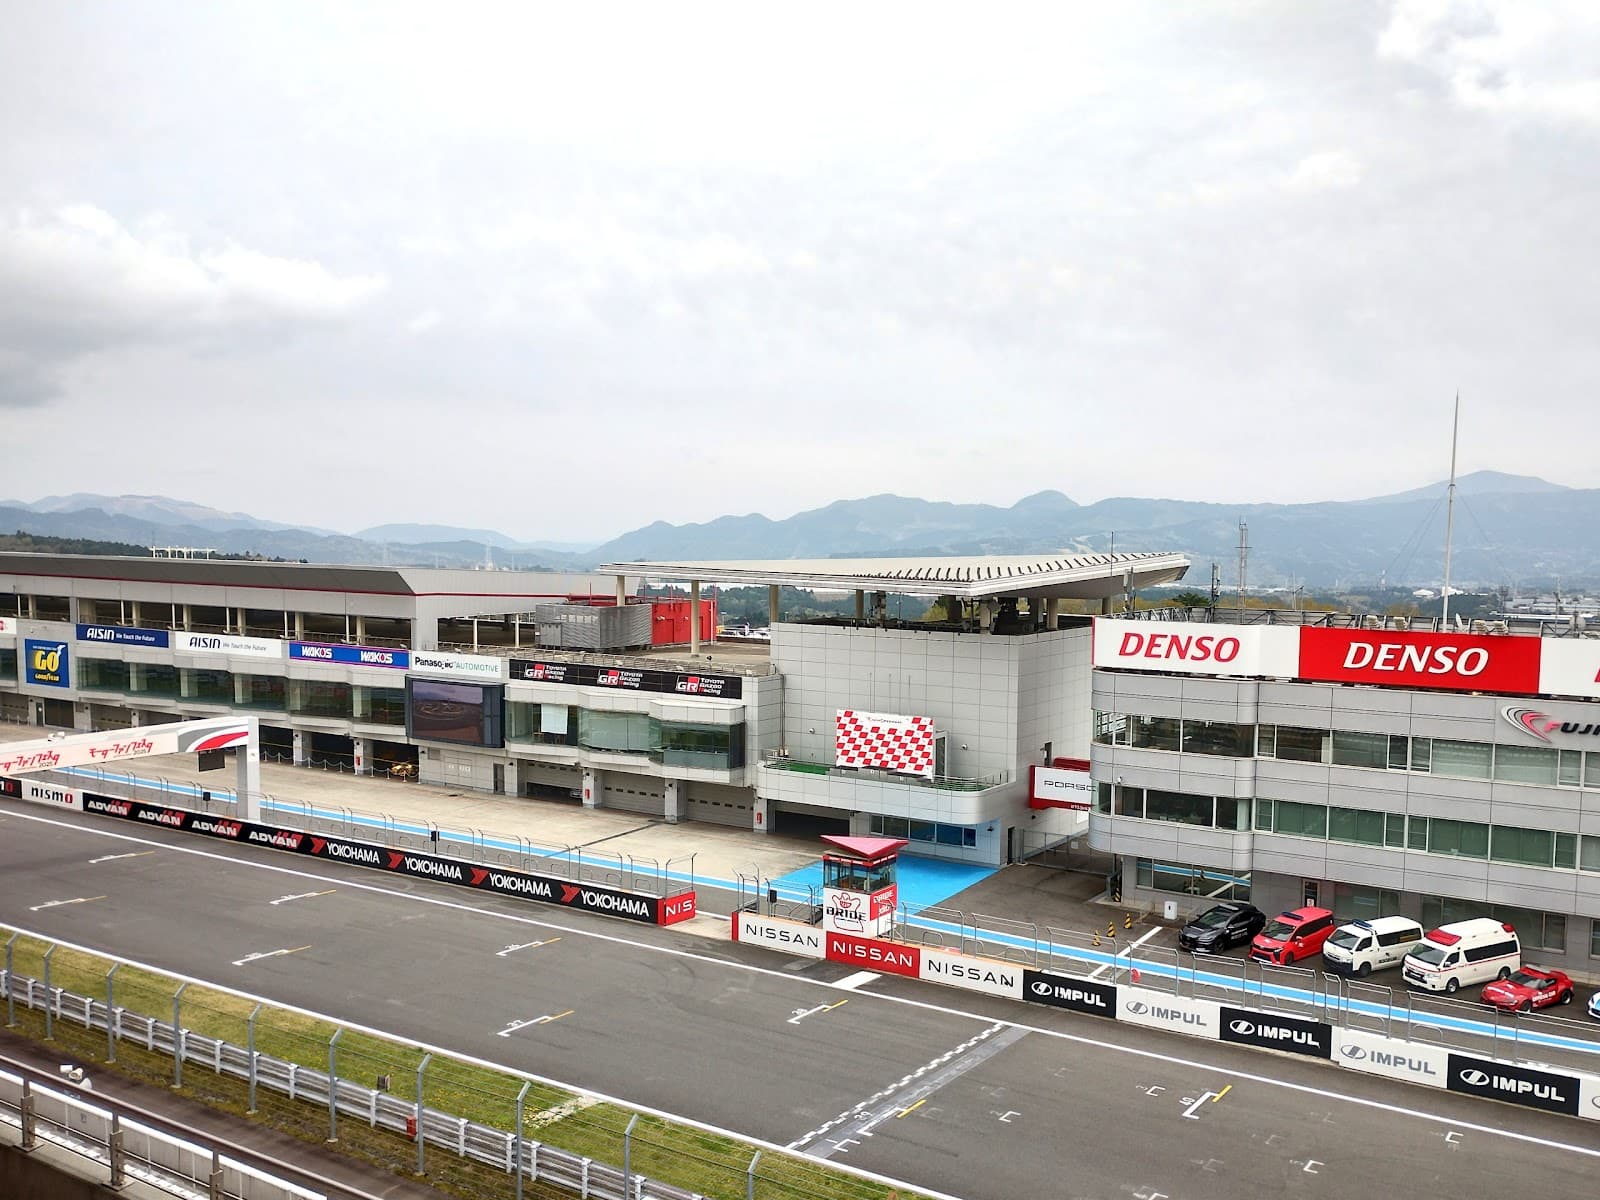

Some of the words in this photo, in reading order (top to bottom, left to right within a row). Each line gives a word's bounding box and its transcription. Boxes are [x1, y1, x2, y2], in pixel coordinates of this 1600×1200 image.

[87, 627, 115, 641] AISIN
[189, 636, 221, 649] AISIN
[1120, 632, 1240, 663] DENSO
[34, 649, 60, 673] GO
[455, 661, 499, 673] AUTOMOTIVE
[1342, 642, 1489, 676] DENSO
[524, 668, 543, 679] GR
[598, 674, 619, 685] GR
[700, 677, 725, 685] TOYOTA
[677, 681, 699, 692] GR
[1043, 780, 1096, 792] PORSC
[87, 800, 128, 816] ADVAN
[137, 810, 181, 827] ADVAN
[191, 820, 237, 837] ADVAN
[248, 831, 298, 848] ADVAN
[326, 842, 381, 864] YOKOHAMA
[404, 857, 463, 881] YOKOHAMA
[489, 872, 552, 898] YOKOHAMA
[581, 890, 650, 917] YOKOHAMA
[665, 901, 696, 918] NIS
[826, 906, 867, 922] BRIDE
[746, 923, 820, 949] NISSAN
[832, 939, 914, 968] NISSAN
[927, 959, 1014, 988] NISSAN
[1054, 985, 1107, 1008] IMPUL
[1150, 1006, 1207, 1027] IMPUL
[1257, 1024, 1320, 1048] IMPUL
[1369, 1049, 1437, 1076] IMPUL
[1492, 1074, 1566, 1102] IMPUL
